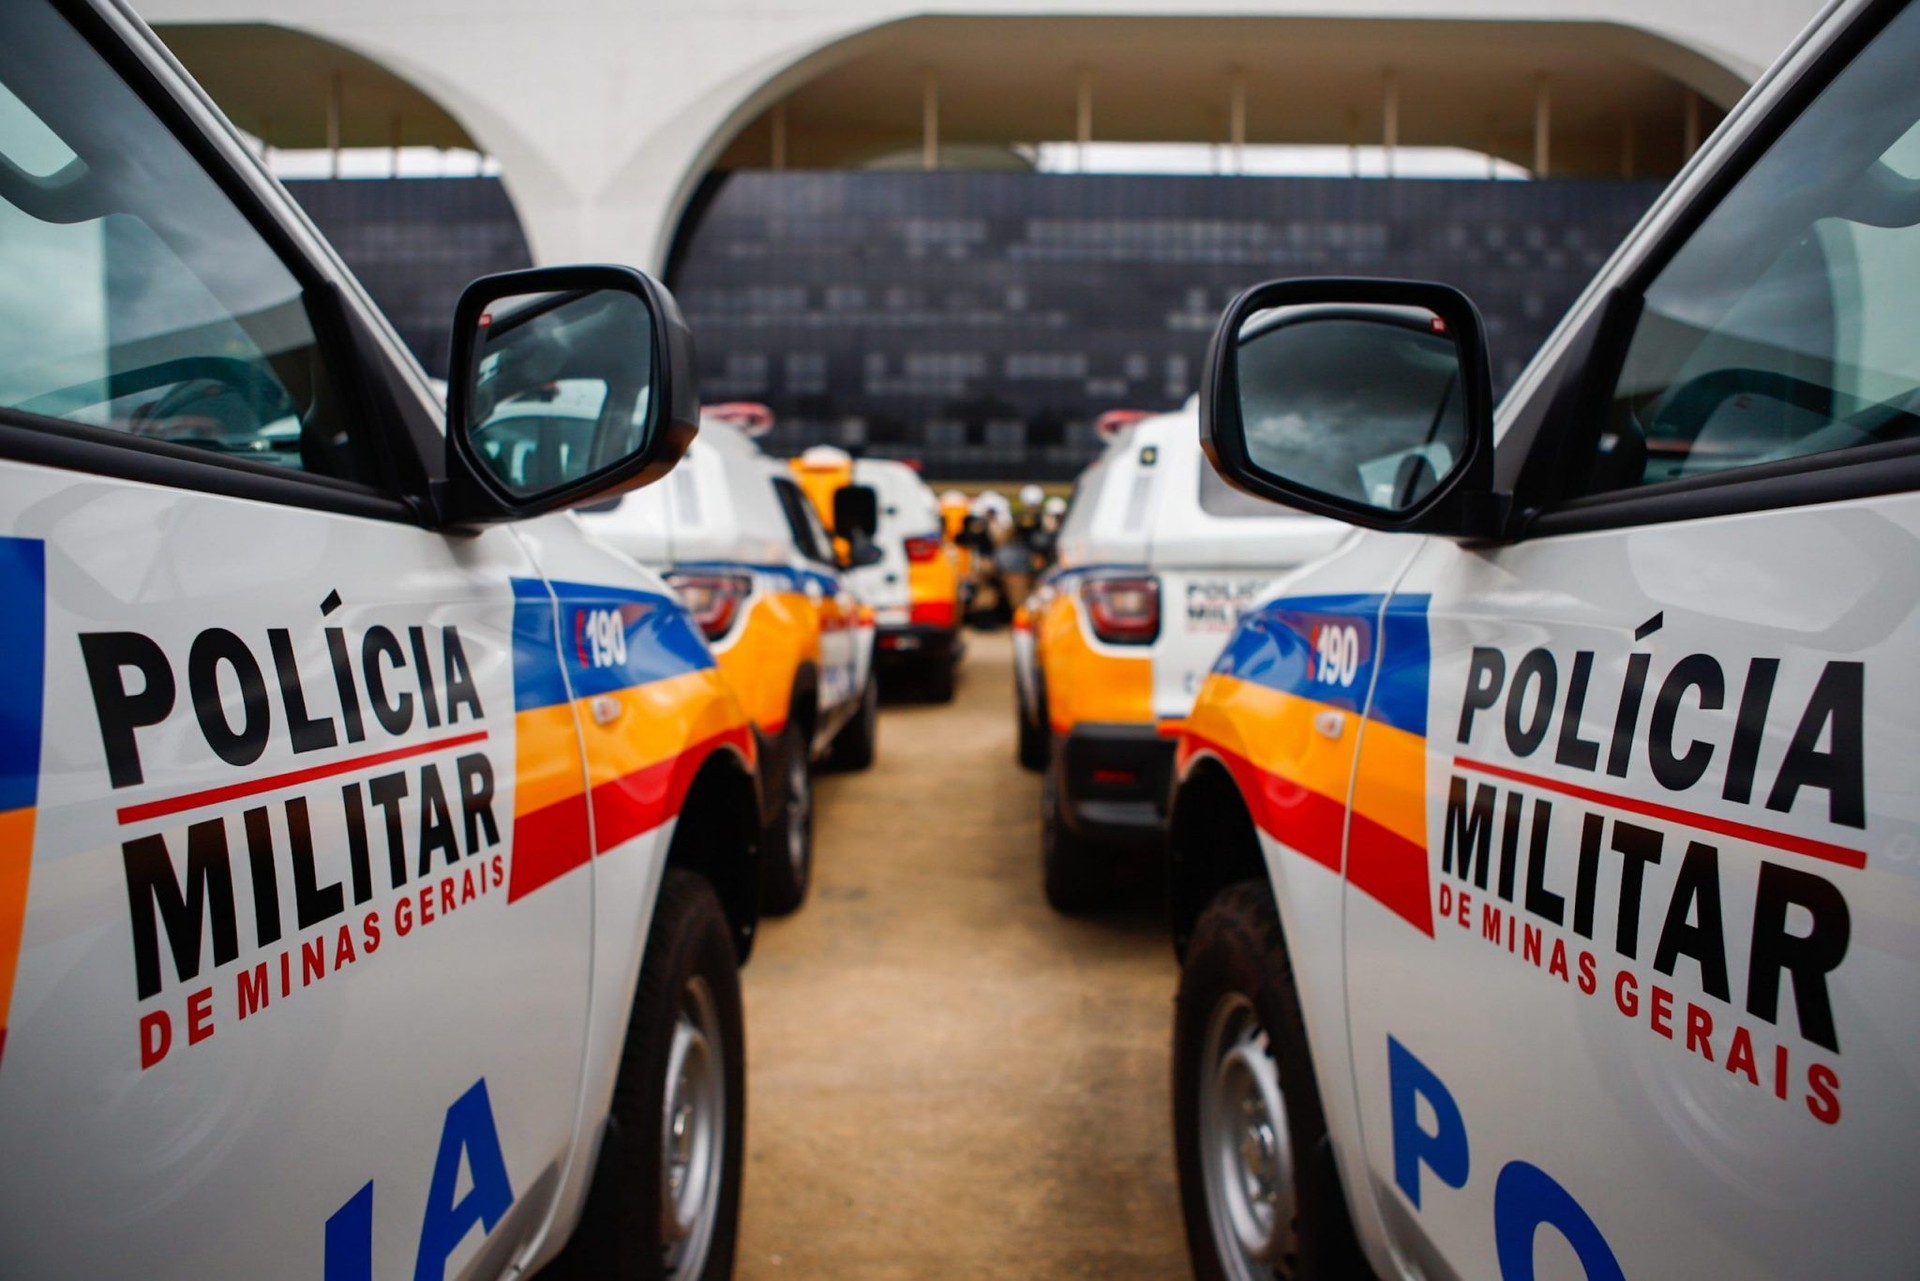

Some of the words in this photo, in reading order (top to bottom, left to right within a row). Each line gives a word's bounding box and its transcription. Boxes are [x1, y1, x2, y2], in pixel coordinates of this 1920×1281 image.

[78, 588, 485, 789] POLÍCIA
[587, 610, 627, 668] 190
[1317, 625, 1359, 688] 190
[1457, 610, 1866, 830] POLÍCIA
[122, 752, 500, 1002] MILITAR
[139, 986, 215, 1071] DE
[236, 912, 381, 1020] MINAS
[394, 854, 504, 937] GERAIS
[1441, 775, 1851, 1055] MILITAR
[1439, 883, 1471, 929] DE
[1482, 902, 1597, 995] MINAS
[1614, 971, 1841, 1125] GERAIS
